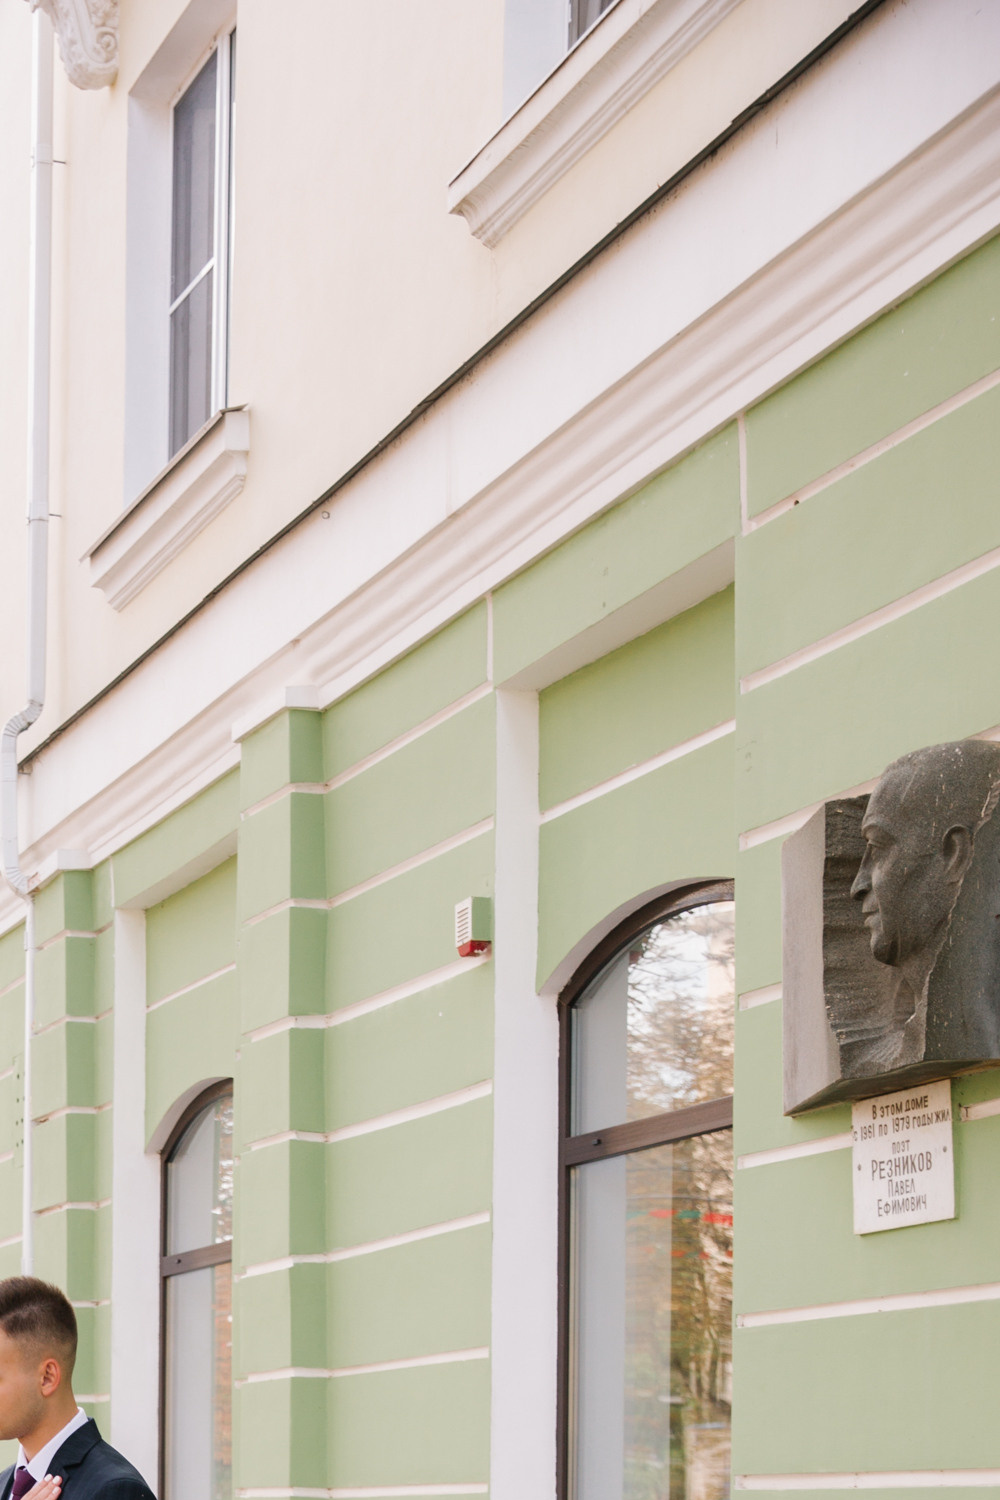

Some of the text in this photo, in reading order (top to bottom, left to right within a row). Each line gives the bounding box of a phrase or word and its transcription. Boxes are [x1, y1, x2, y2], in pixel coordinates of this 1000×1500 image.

[872, 1104, 878, 1120] В
[904, 1095, 929, 1112] ДОМЕ
[892, 1115, 911, 1134] 1979
[871, 1151, 933, 1181] РЕЗНИКОВ
